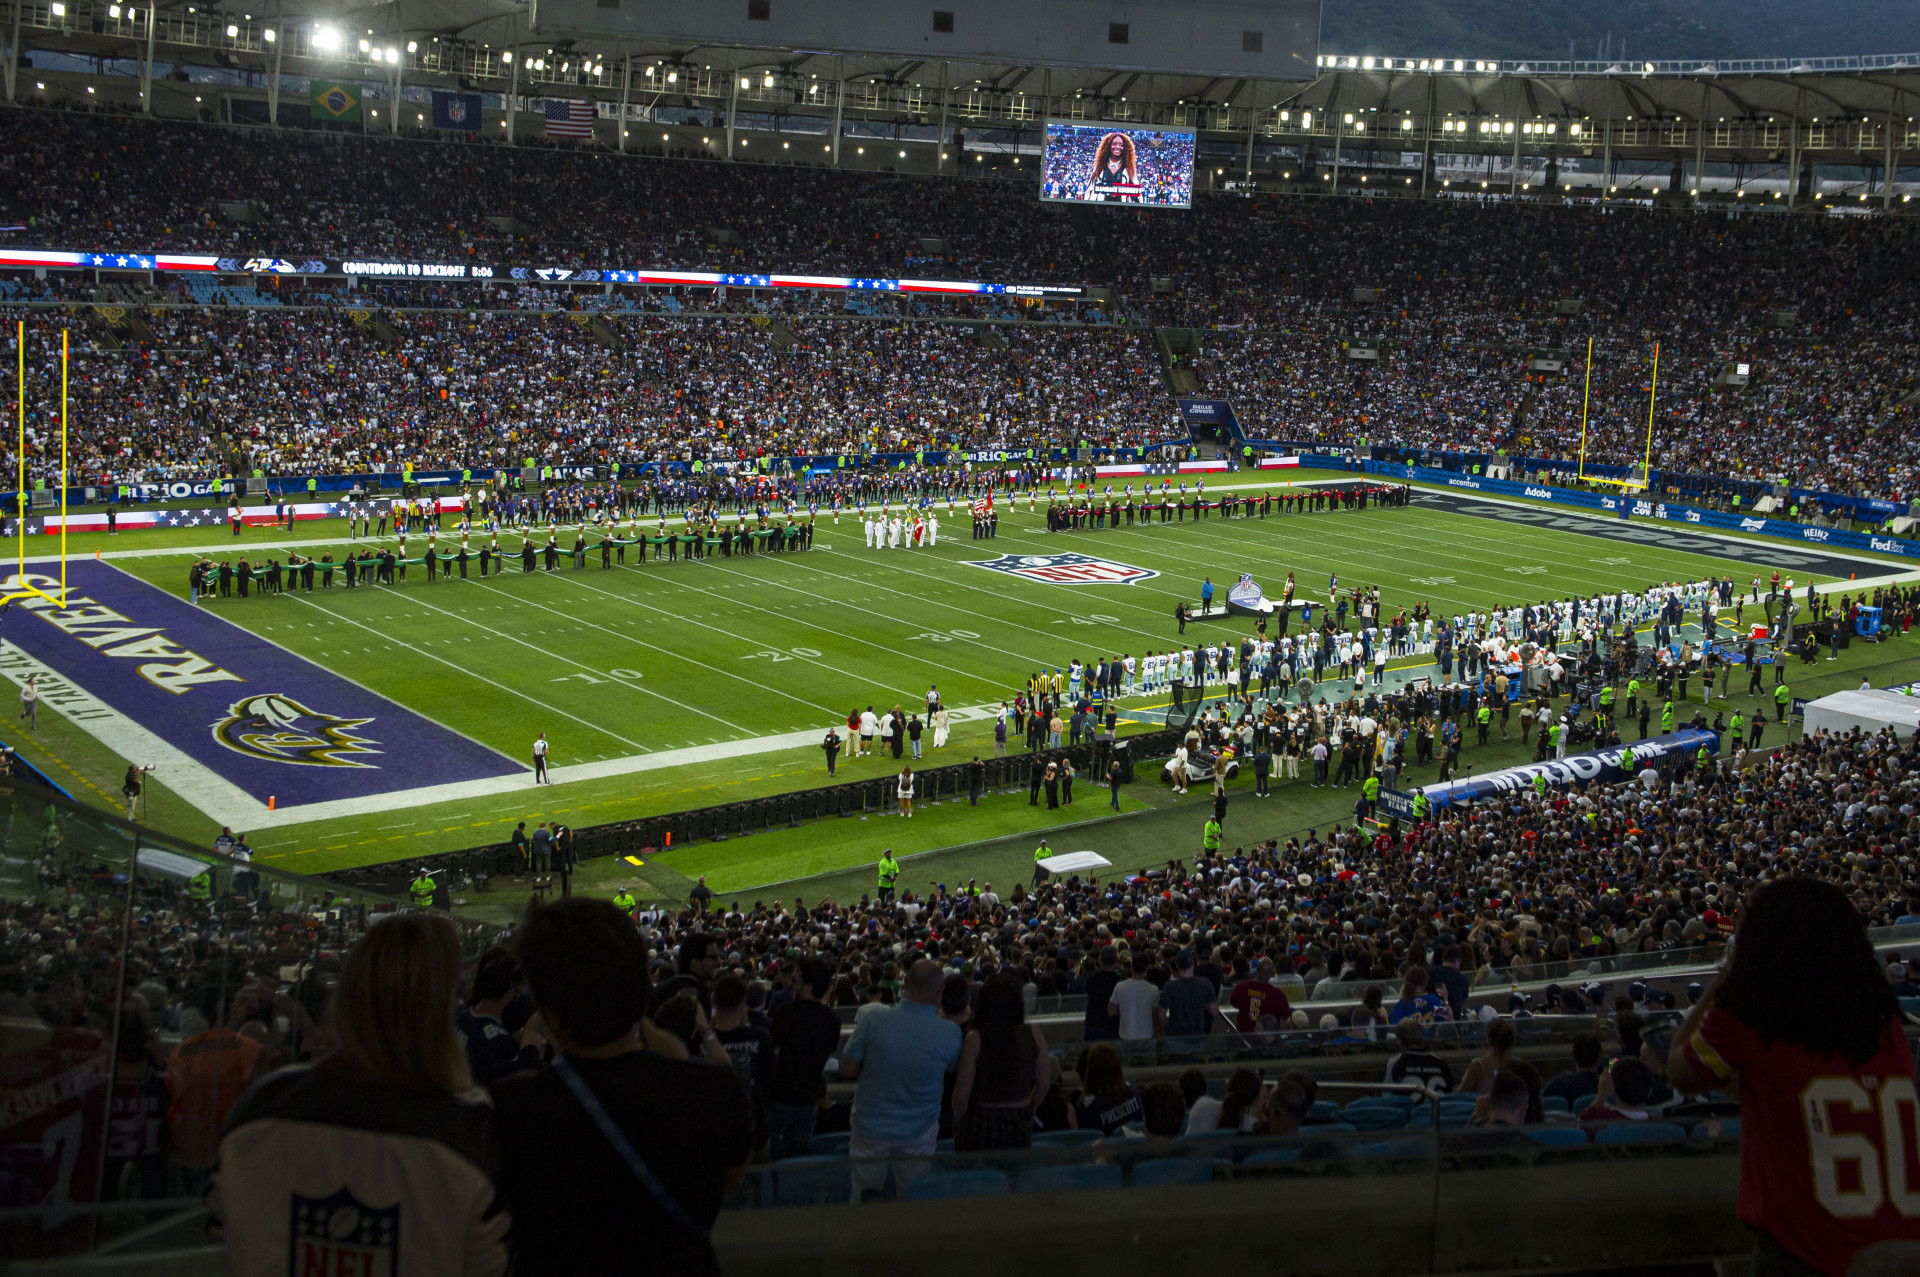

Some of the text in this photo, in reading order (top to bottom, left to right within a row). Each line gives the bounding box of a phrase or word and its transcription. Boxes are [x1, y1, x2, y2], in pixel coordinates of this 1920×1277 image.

[451, 109, 464, 119] NFL
[342, 262, 493, 278] COUNTDOWN TO KICKOFF 5:06
[1448, 478, 1480, 488] accenture
[1524, 486, 1552, 498] Adobe
[1457, 506, 1829, 566] COWBOYS
[1804, 528, 1829, 540] HEINZ
[1870, 538, 1904, 553] FedEx
[1018, 564, 1143, 582] NFL
[1071, 614, 1120, 626] 40
[0, 574, 248, 695] RAVENS
[920, 630, 980, 642] 30
[756, 648, 822, 662] 20
[568, 668, 644, 684] 10
[15, 672, 90, 705] TAKES
[66, 708, 114, 720] IT
[1487, 774, 1526, 792] NFL
[1380, 791, 1414, 808] AMERICA'S
[1388, 800, 1407, 812] TEAM
[1249, 997, 1261, 1022] 5
[1100, 1096, 1140, 1126] PRESCOTT
